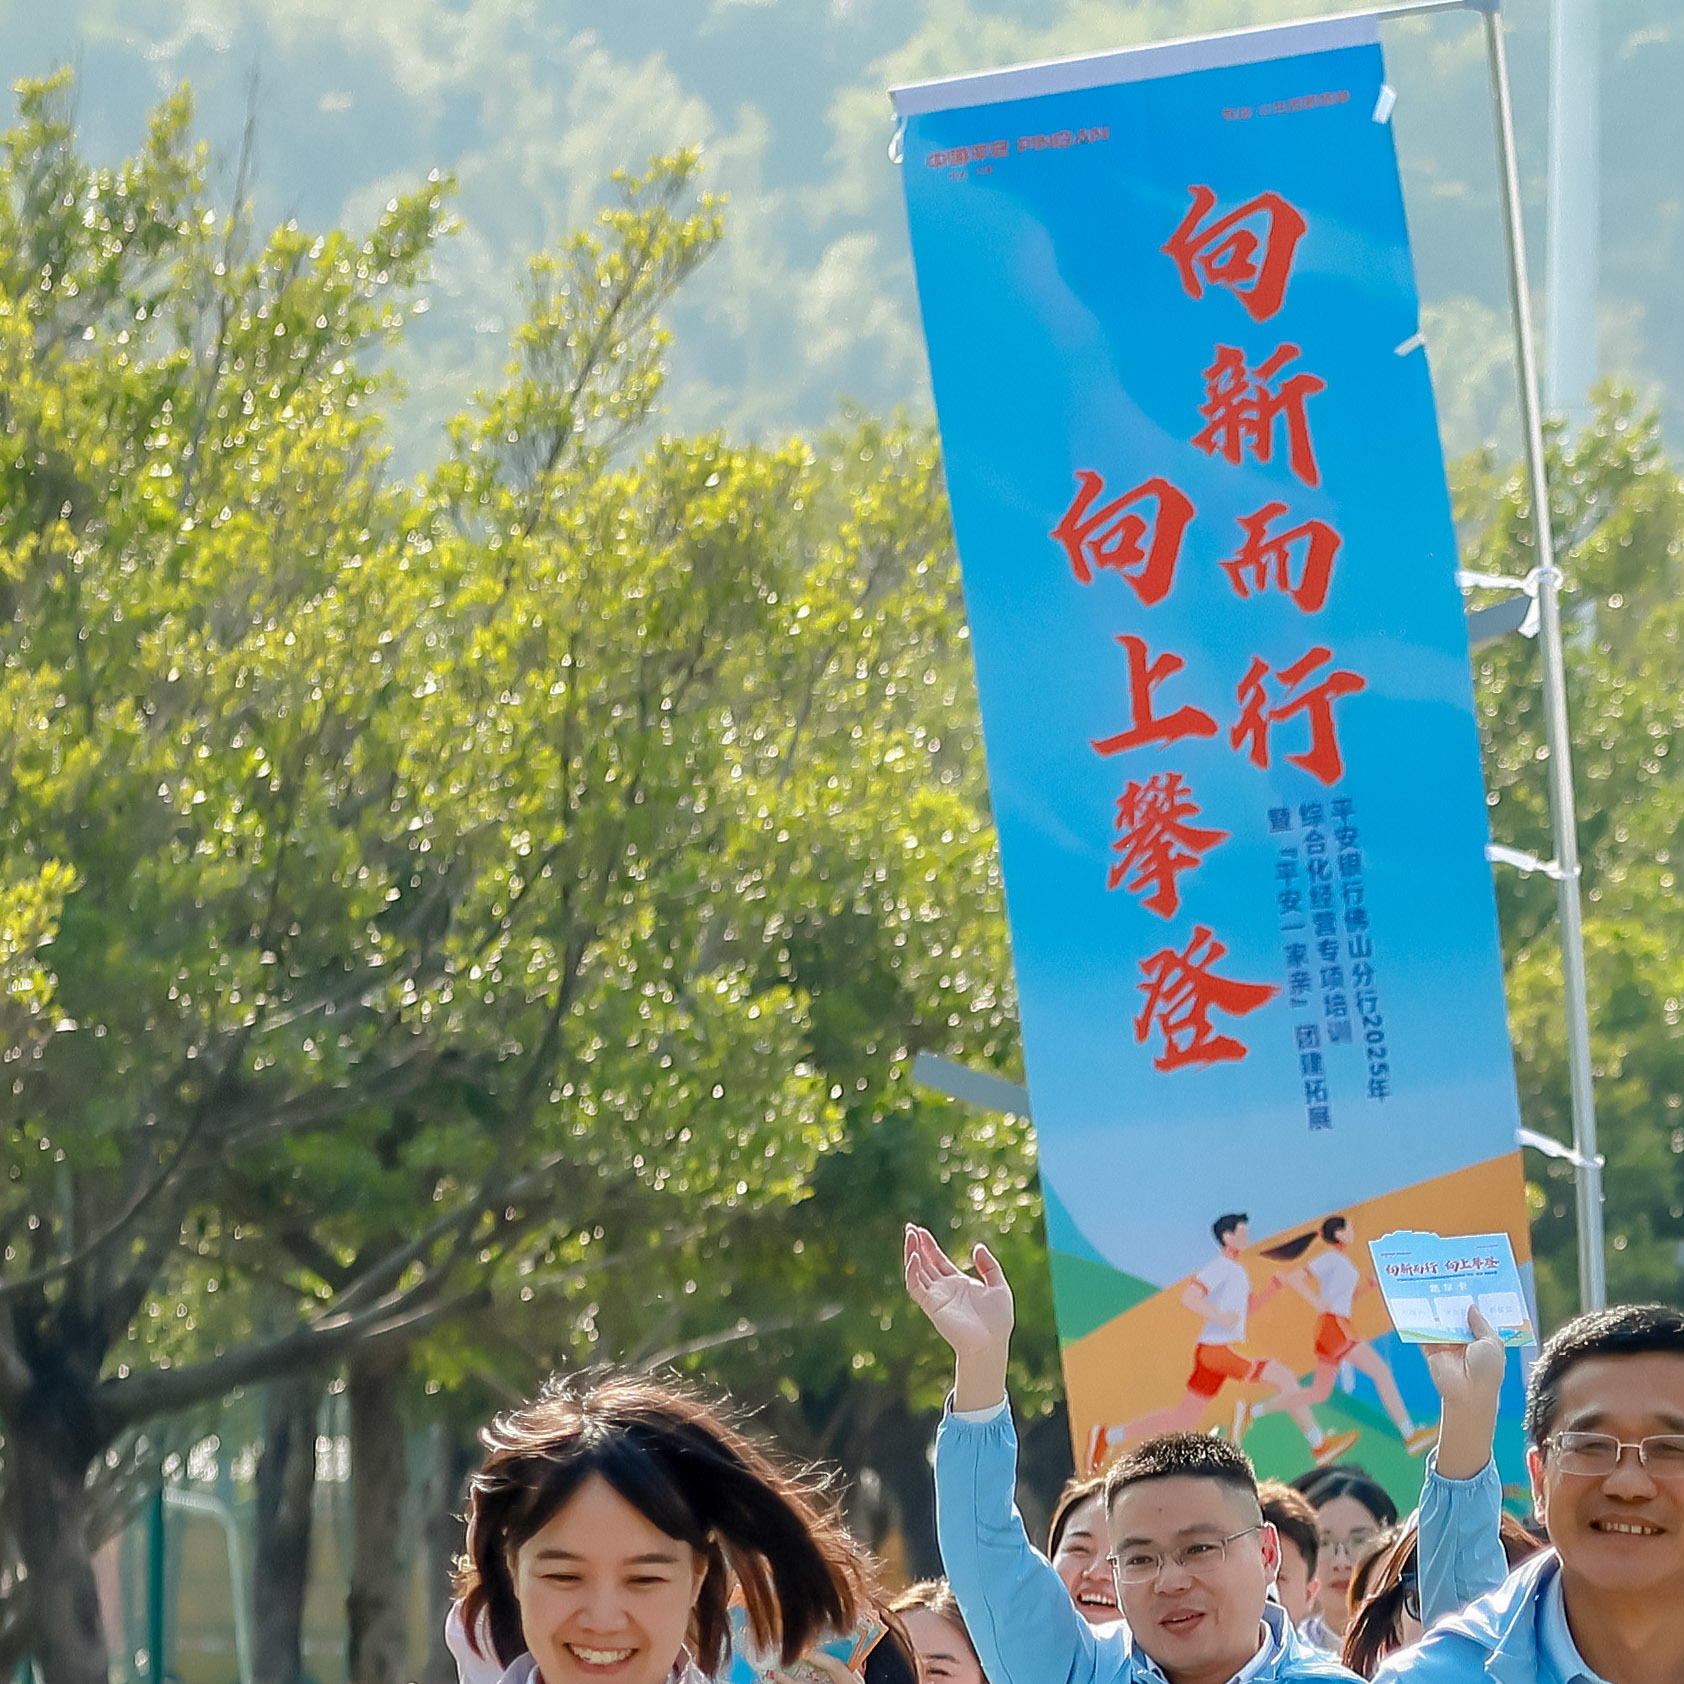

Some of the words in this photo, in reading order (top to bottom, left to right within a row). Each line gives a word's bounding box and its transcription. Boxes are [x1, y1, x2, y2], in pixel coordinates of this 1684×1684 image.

[1051, 470, 1283, 1073] 向上攀登
[1160, 185, 1367, 786] 向新而行
